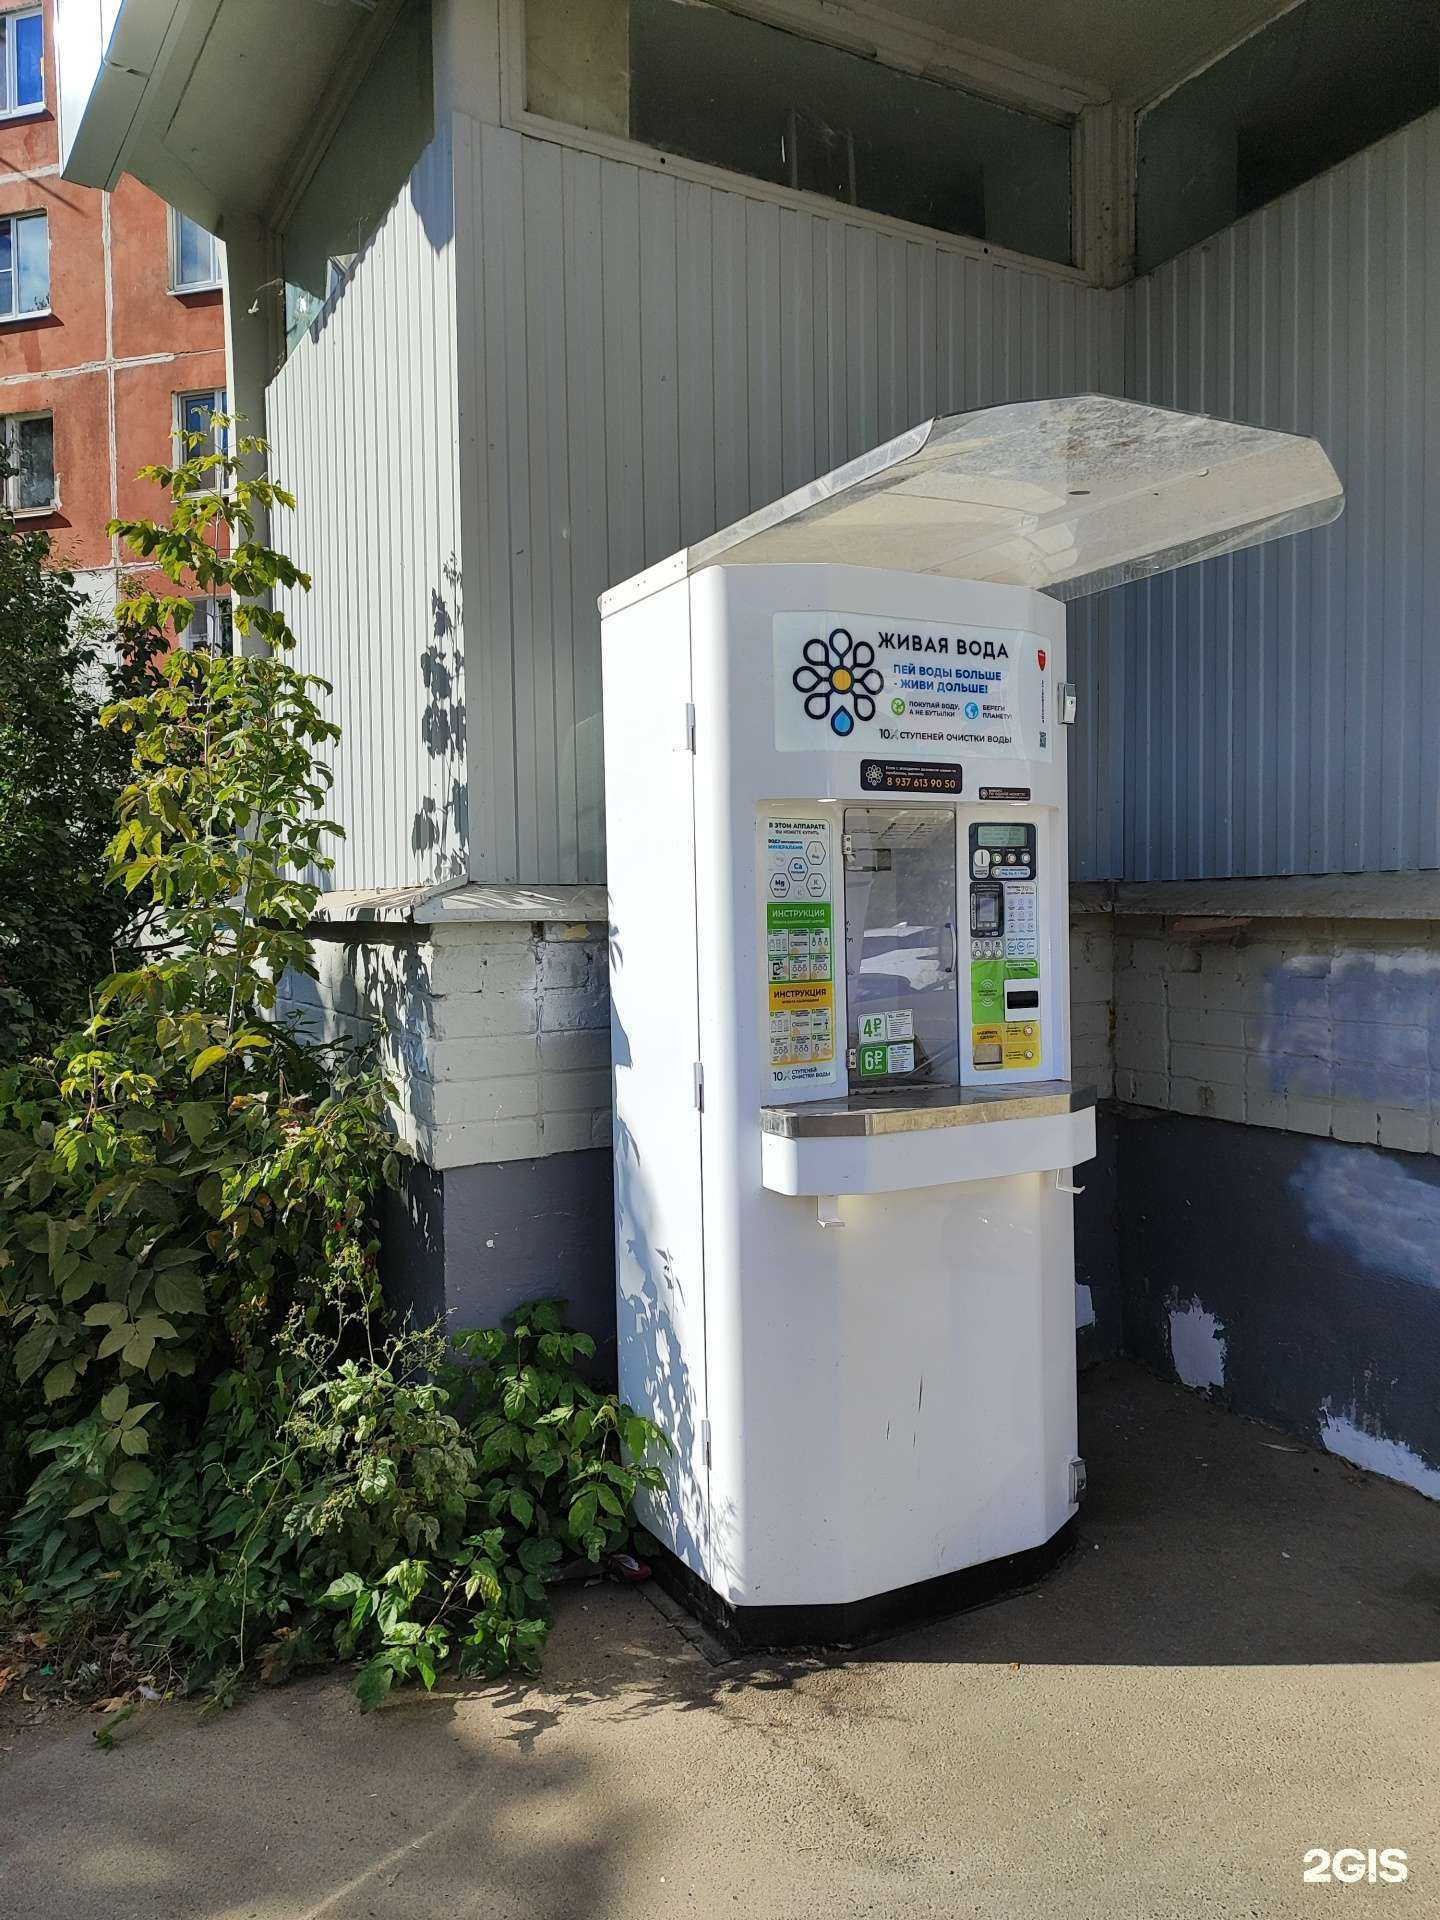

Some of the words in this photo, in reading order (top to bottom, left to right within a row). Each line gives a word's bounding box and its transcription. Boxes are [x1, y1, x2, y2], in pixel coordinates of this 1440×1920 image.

[878, 632, 948, 654] ЖИВАЯ
[957, 639, 1009, 659] ВОДА
[893, 663, 915, 675] ПЕЙ
[919, 666, 952, 678] ВОДЫ
[955, 669, 1002, 681] БОЛЬШЕ
[900, 679, 934, 690] ЖИВИ
[937, 682, 988, 694] ДОЛЬШЕ!
[909, 700, 940, 709] ПОКУПАЙ
[900, 730, 944, 741] СТУПЕНЕЙ
[946, 732, 985, 743] ОЧИСТКИ
[987, 735, 1012, 744] ВОДЫ
[886, 777, 893, 786] 8
[895, 777, 912, 786] 937
[914, 778, 928, 788] 613
[930, 779, 942, 788] 90
[944, 779, 956, 789] 50
[772, 908, 825, 918] ИНСТРУКЦИЯ
[773, 988, 827, 999] ИНСТРУКЦИЯ
